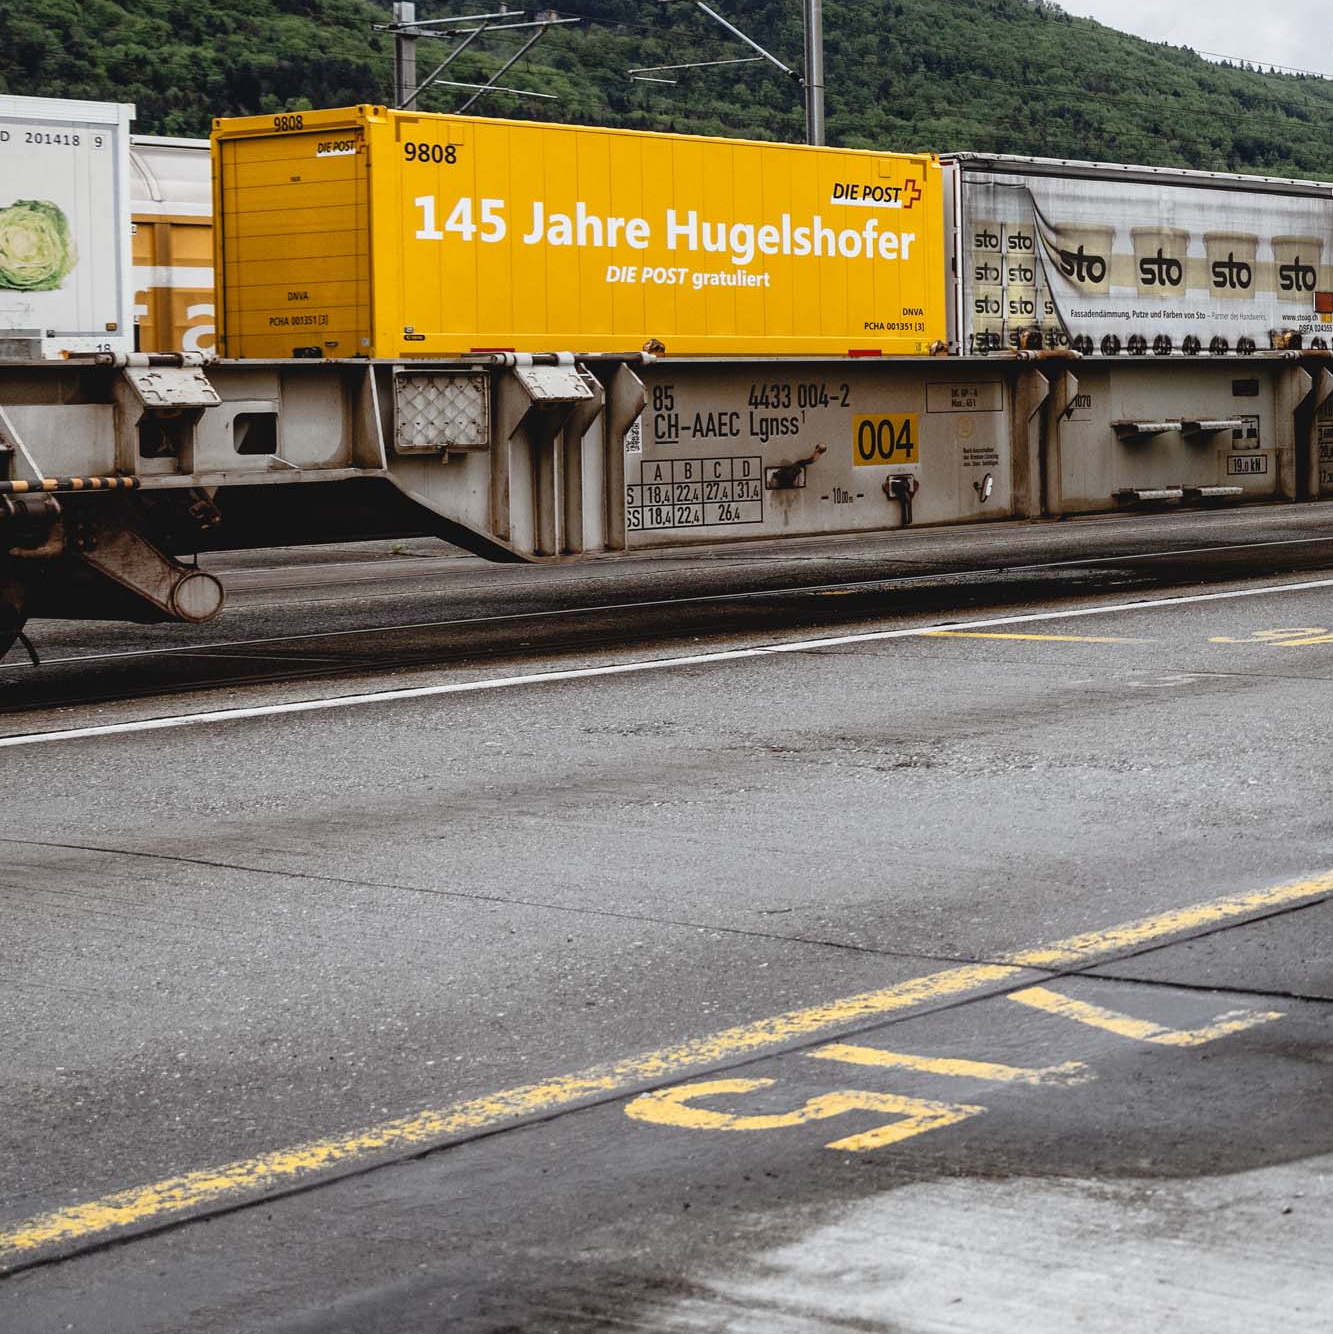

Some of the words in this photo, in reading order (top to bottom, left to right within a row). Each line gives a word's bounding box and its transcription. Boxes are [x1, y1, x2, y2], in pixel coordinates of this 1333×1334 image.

[273, 114, 304, 132] 9808
[25, 132, 81, 147] 201418
[94, 136, 103, 148] 9
[317, 141, 332, 154] DIE
[333, 139, 356, 153] POST
[403, 141, 457, 165] 9808
[832, 182, 860, 200] DIE
[862, 185, 902, 204] POST
[413, 194, 507, 243] 145
[523, 201, 650, 251] Jahre
[665, 210, 916, 265] Hugelshofer
[974, 229, 999, 249] sto
[1007, 231, 1033, 250] sto
[975, 262, 1000, 281] sto
[1008, 263, 1033, 283] sto
[1059, 244, 1107, 283] sto
[1139, 248, 1183, 287] sto
[1211, 251, 1252, 290] sto
[1279, 255, 1317, 292] sto
[605, 265, 638, 284] DIE
[641, 266, 688, 286] POST
[692, 269, 771, 290] gratuliert
[902, 307, 924, 316] DNVA
[975, 295, 1000, 314] sto
[1009, 296, 1034, 315] sto
[1070, 309, 1131, 321] Fassadendämmung,
[1132, 310, 1149, 319] Putze
[1150, 310, 1162, 319] und
[1163, 310, 1183, 320] Farben
[1196, 311, 1206, 320] Sto
[1281, 313, 1319, 323] www.stoag.ch
[864, 321, 885, 331] PCHA
[886, 322, 913, 332] 001351
[653, 385, 675, 412] 85
[748, 383, 792, 409] 4433
[797, 382, 851, 408] 004-2
[654, 412, 740, 440] CH-AAEC
[857, 418, 914, 461] 004
[654, 463, 663, 481] A
[684, 462, 693, 480] B
[713, 461, 722, 478] C
[742, 460, 751, 478] D
[1249, 456, 1261, 472] kN
